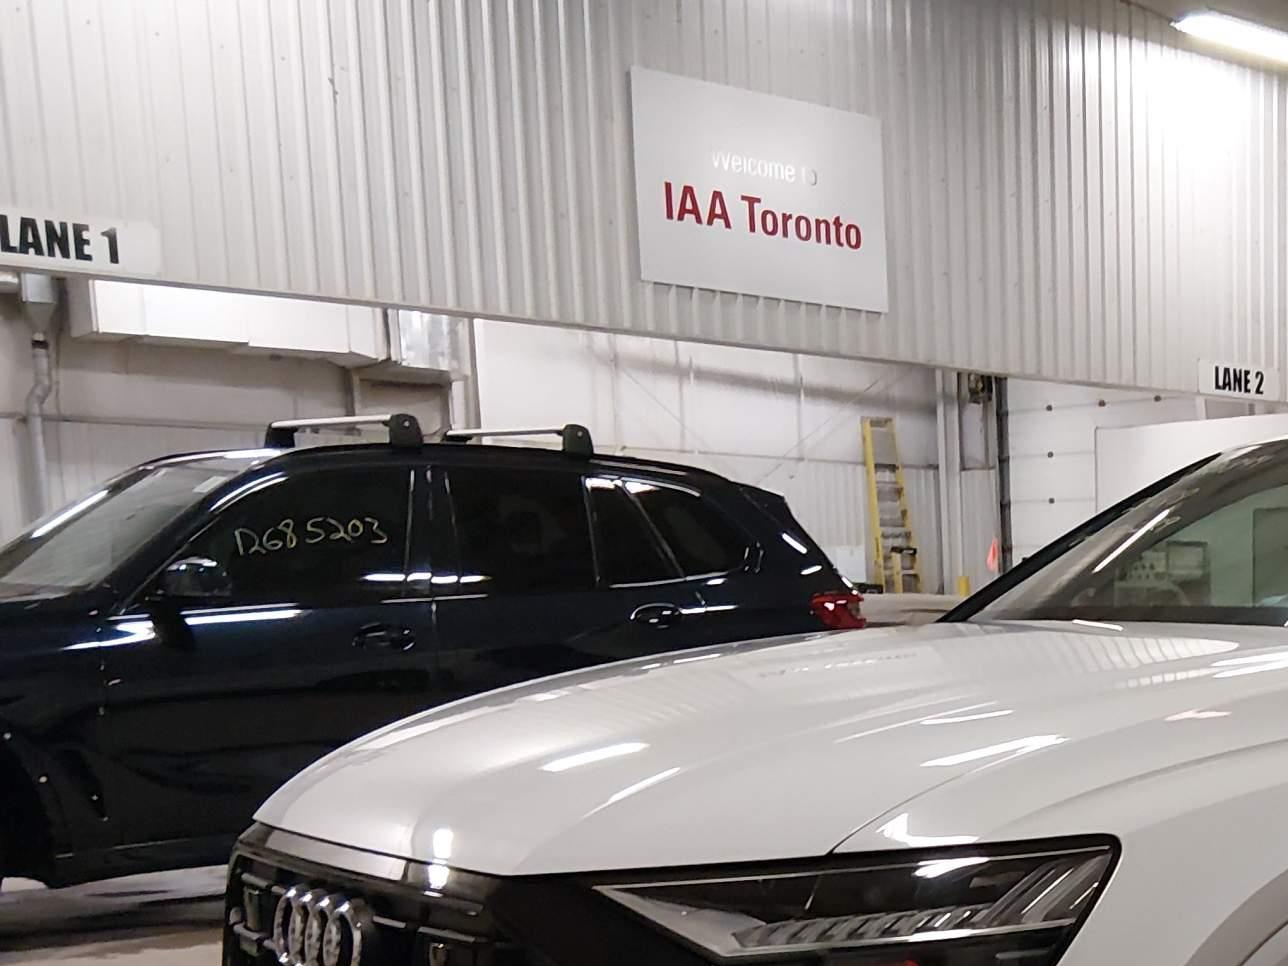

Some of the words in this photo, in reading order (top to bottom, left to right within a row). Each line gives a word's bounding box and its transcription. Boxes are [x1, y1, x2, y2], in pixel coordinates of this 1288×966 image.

[711, 150, 797, 184] Welcome
[664, 181, 732, 230] IAA
[740, 194, 862, 251] Toronto
[0, 213, 93, 262] LANE
[100, 226, 119, 265] 1
[1214, 365, 1251, 394] LANE
[1254, 370, 1265, 395] 2
